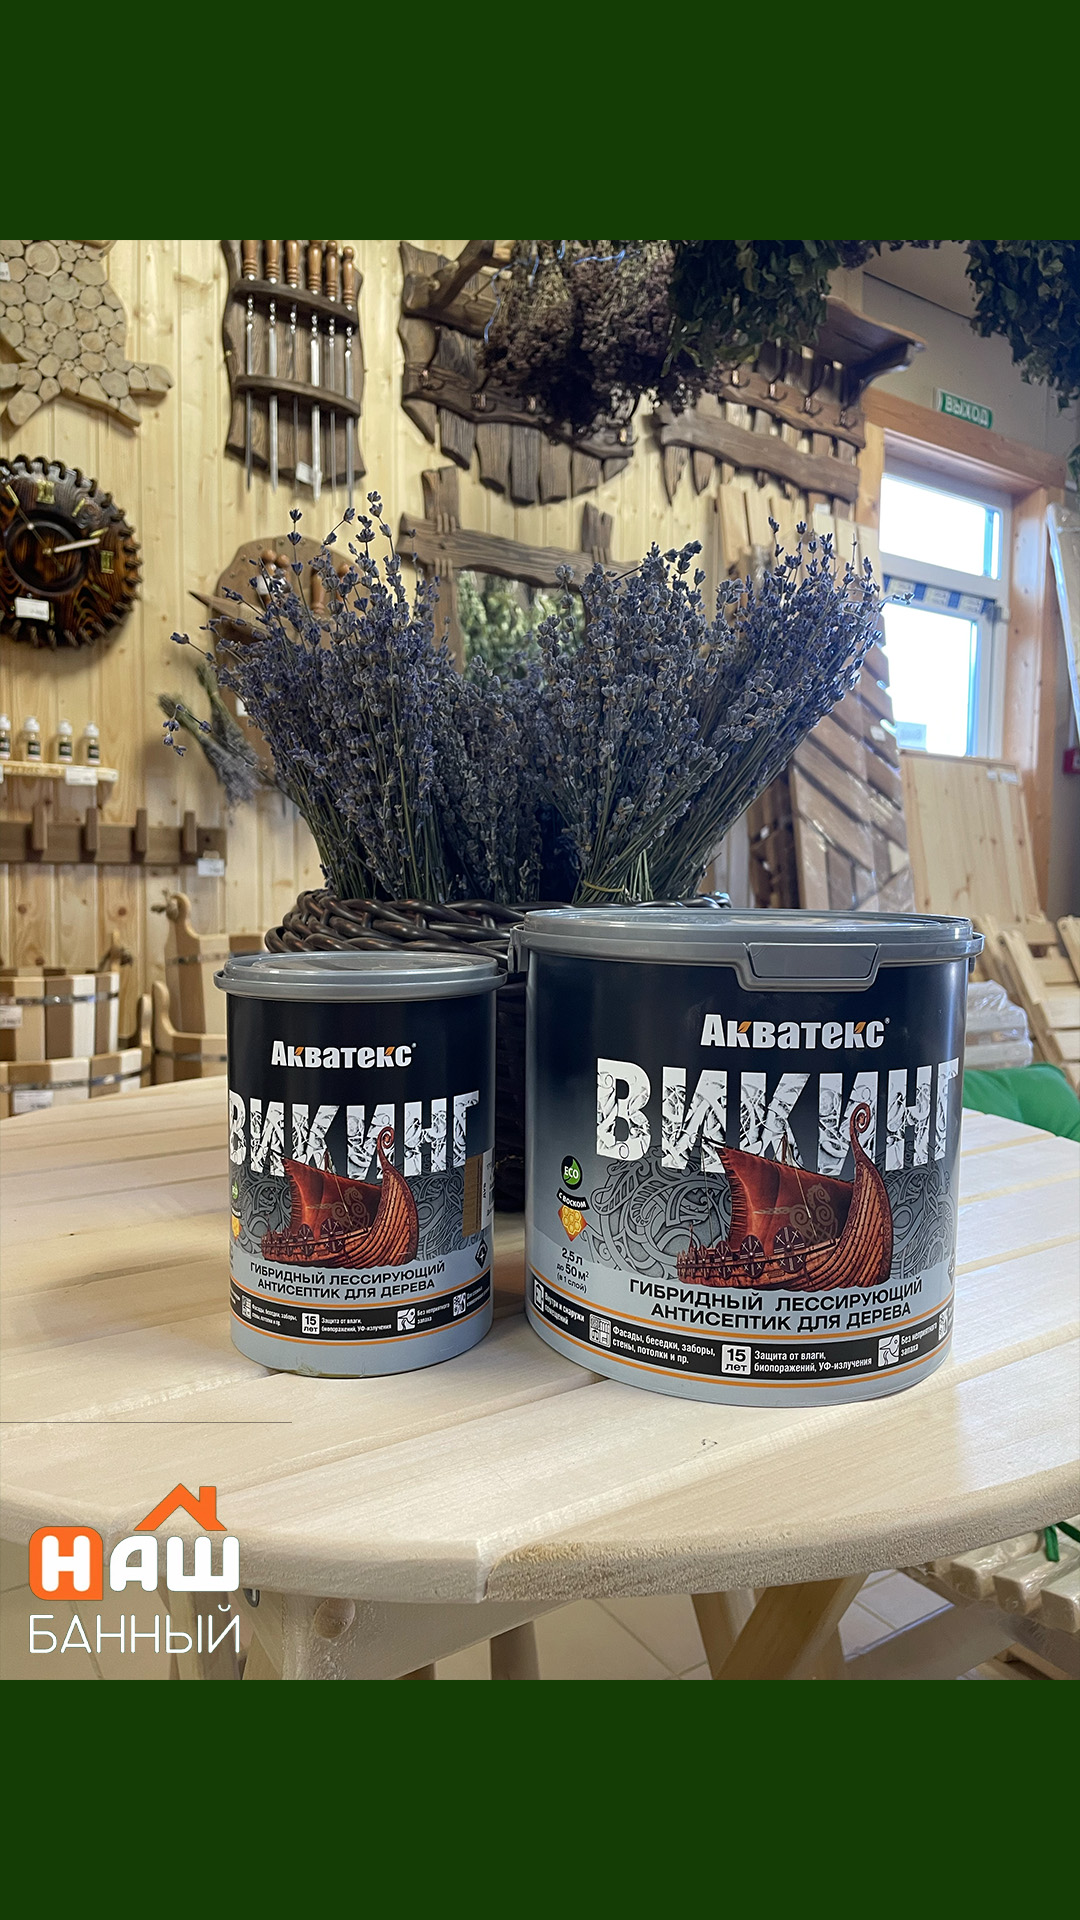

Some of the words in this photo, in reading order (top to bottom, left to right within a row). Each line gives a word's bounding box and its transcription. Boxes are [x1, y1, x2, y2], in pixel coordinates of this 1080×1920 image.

[944, 396, 989, 426] ВЫХОД
[596, 1057, 959, 1177] ВИКИНГ
[229, 1089, 480, 1181] ВИКИНГ
[563, 1166, 579, 1180] ECO
[561, 1247, 575, 1263] 2,5
[250, 1262, 326, 1285] ГИБРИДНЫЙ
[329, 1260, 446, 1286] ЛЕССИРУЮЩИЙ
[565, 1263, 577, 1277] 50
[257, 1278, 341, 1299] АНТИСЕПТИК
[344, 1288, 376, 1301] ДЛЯ
[380, 1279, 435, 1298] ДЕРЕВА
[629, 1278, 763, 1311] ГИБРИДНЫЙ
[775, 1276, 922, 1312] ЛЕССИРУЮЩИЙ
[305, 1315, 317, 1326] 15
[651, 1303, 791, 1331] АНТИСЕПТИК
[797, 1314, 840, 1333] ДЛЯ
[847, 1302, 911, 1330] ДЕРЕВА
[613, 1326, 644, 1343] Фасады,
[645, 1335, 680, 1351] беседки,
[681, 1344, 715, 1356] заборы,
[613, 1338, 636, 1353] стены,
[637, 1346, 668, 1360] потолки
[677, 1355, 689, 1364] пр.
[727, 1349, 746, 1361] 15
[754, 1350, 787, 1361] Защита
[789, 1352, 799, 1360] от
[800, 1351, 826, 1360] влаги,
[754, 1362, 817, 1374] биопоражений,
[818, 1357, 872, 1371] УФ-излучения
[725, 1364, 747, 1372] лет
